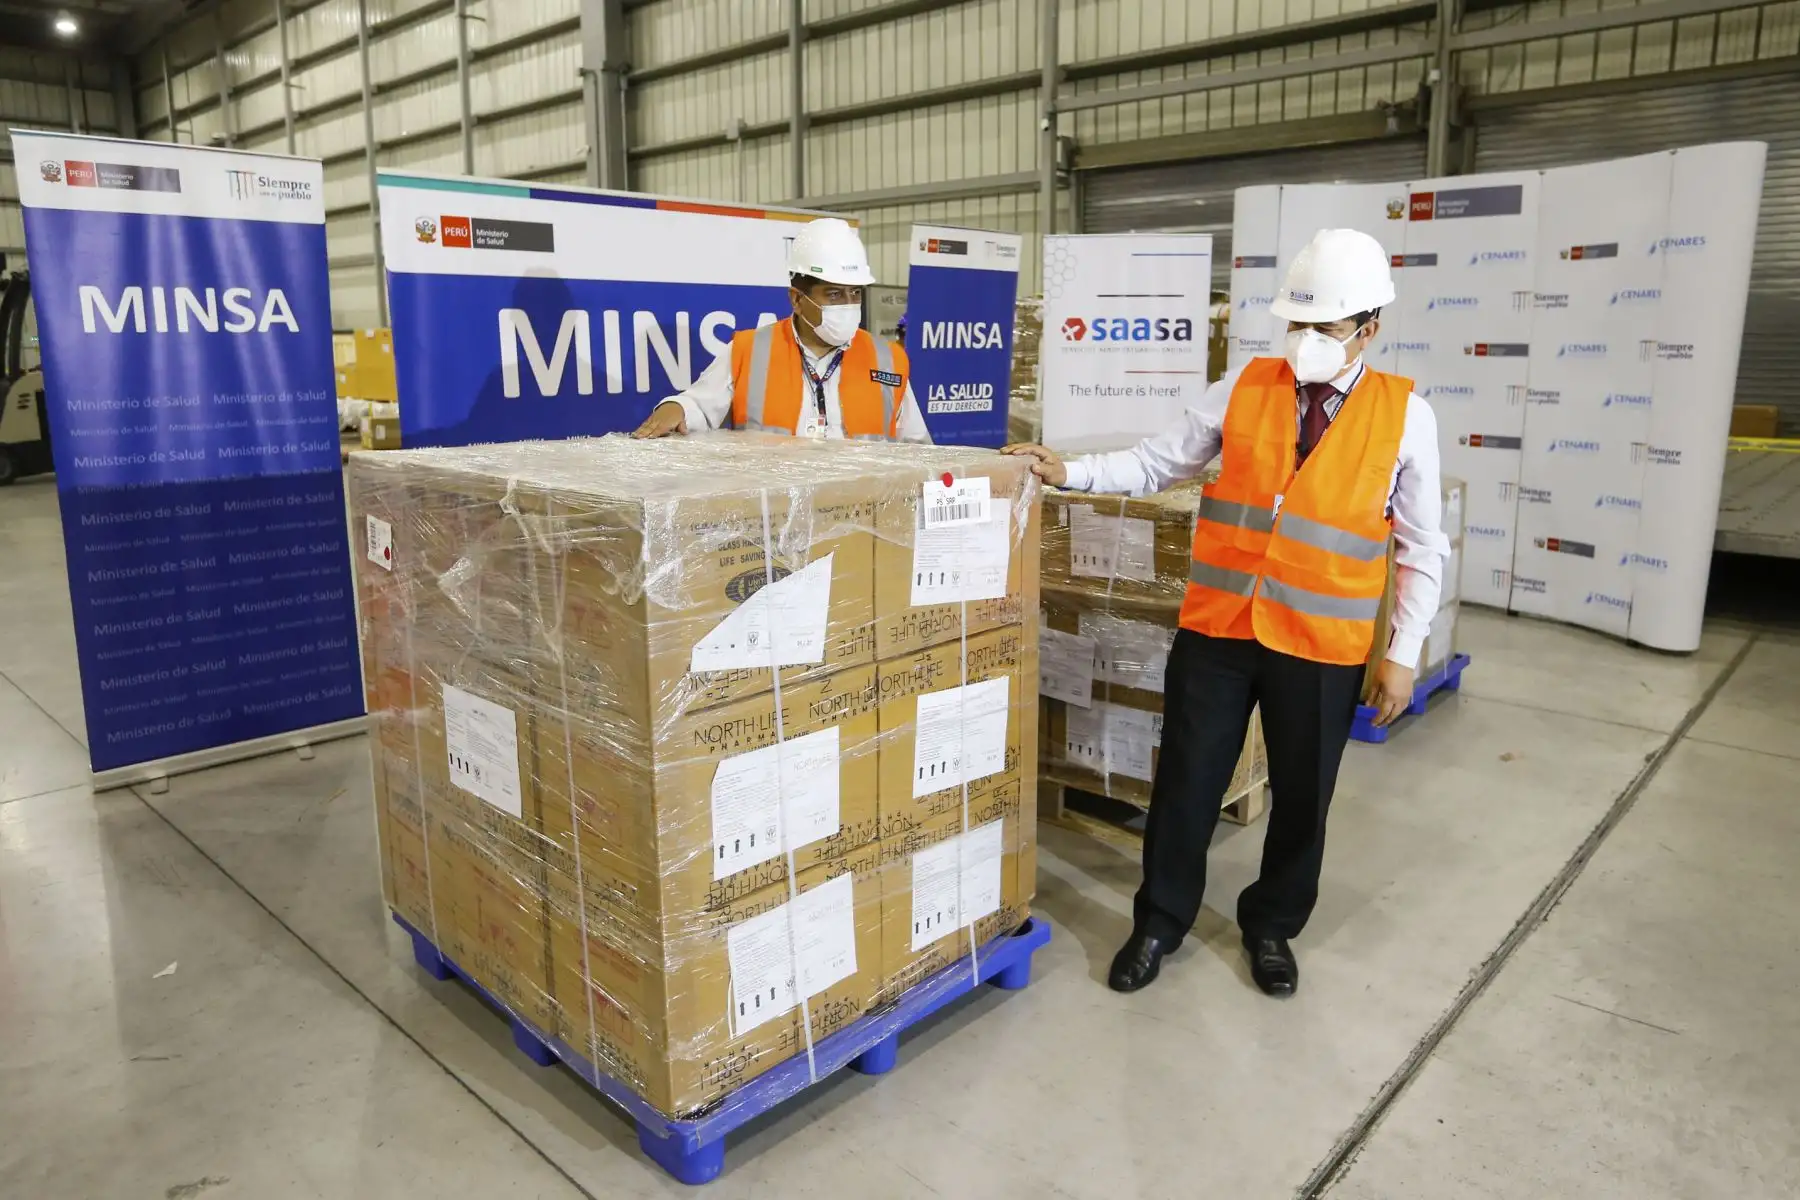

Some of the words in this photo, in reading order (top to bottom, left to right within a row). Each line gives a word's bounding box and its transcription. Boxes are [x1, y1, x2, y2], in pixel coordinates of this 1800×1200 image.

[258, 176, 312, 192] Siempre
[278, 190, 312, 201] pueblo
[444, 225, 468, 238] PERÚ
[476, 228, 509, 239] Ministerio
[486, 238, 505, 246] Salud
[1658, 236, 1706, 249] CENARES
[1480, 250, 1527, 260] CENARES
[1436, 296, 1480, 306] CENARES
[1533, 292, 1570, 303] Siempre
[1620, 289, 1662, 301] CENARES
[78, 285, 300, 334] MINSA
[921, 321, 1003, 349] MINSA
[1091, 317, 1193, 342] saasa
[1567, 342, 1608, 353] CENARES
[1656, 342, 1695, 353] Siempre
[213, 392, 275, 405] Ministerio
[278, 391, 293, 402] de
[297, 390, 327, 401] Salud
[928, 384, 947, 401] LA
[948, 383, 994, 400] SALUD
[1068, 384, 1091, 397] The
[1094, 383, 1134, 397] future
[1136, 384, 1147, 397] is
[1149, 384, 1181, 397] here!
[1433, 385, 1475, 396] CENARES
[66, 397, 140, 412] Ministerio
[144, 397, 160, 408] de
[161, 394, 201, 407] Salud
[930, 403, 940, 412] ES
[941, 402, 953, 411] TU
[955, 401, 990, 411] DERECHO
[1614, 394, 1653, 405] CENARES
[218, 445, 280, 458] Ministerio
[282, 443, 297, 454] de
[300, 440, 331, 452] Salud
[1557, 439, 1601, 452] CENARES
[1647, 445, 1682, 458] Siempre
[74, 453, 145, 468] Ministerio
[148, 451, 165, 463] de
[168, 448, 206, 461] Salud
[223, 498, 283, 512] Ministerio
[287, 496, 302, 507] de
[305, 492, 335, 503] Salud
[1605, 494, 1642, 510] CENARES
[81, 511, 152, 526] Ministerio
[155, 508, 172, 519] de
[175, 503, 212, 516] Salud
[229, 550, 288, 564] Ministerio
[291, 546, 307, 557] de
[309, 540, 341, 553] Salud
[718, 540, 741, 552] GLASS
[719, 556, 735, 568] LIFE
[740, 551, 767, 564] SAVING
[1629, 553, 1669, 569] CENARES
[88, 565, 157, 582] Ministerio
[161, 561, 178, 573] de
[181, 557, 216, 570] Salud
[233, 597, 293, 615] Ministerio
[295, 592, 311, 604] de
[312, 588, 344, 601] Salud
[94, 617, 163, 636] Ministerio
[166, 613, 183, 625] de
[186, 607, 221, 622] Salud
[100, 669, 169, 690] Ministerio
[172, 665, 188, 678] de
[191, 658, 227, 673] Salud
[106, 722, 176, 743] Ministerio
[179, 716, 194, 729] de
[197, 708, 232, 725] Salud
[709, 730, 777, 755] PHARMA
